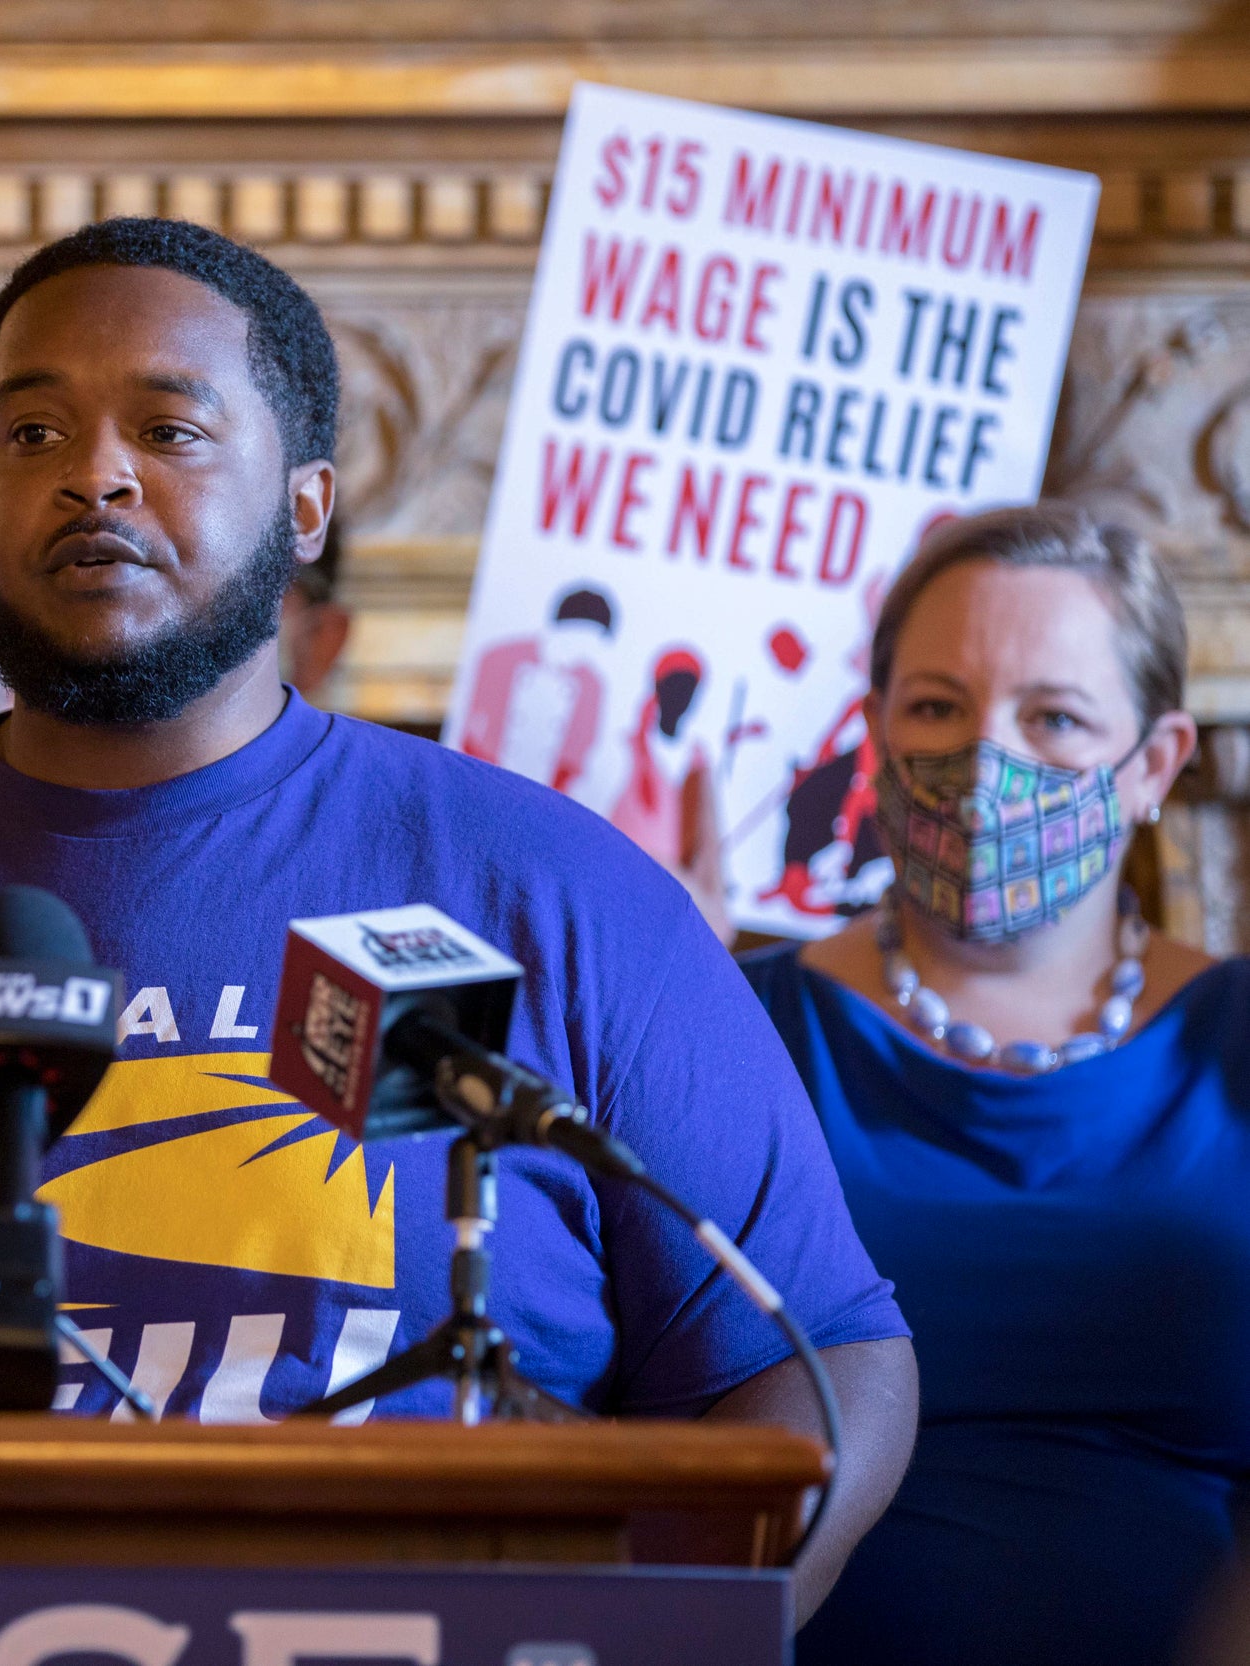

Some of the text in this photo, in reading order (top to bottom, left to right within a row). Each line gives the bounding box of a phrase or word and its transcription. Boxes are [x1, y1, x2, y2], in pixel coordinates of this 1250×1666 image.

[593, 131, 1043, 284] $15 MINIMUM
[580, 230, 1024, 399] WAGE IS THE
[551, 336, 1000, 494] COVID RELIEF
[537, 438, 871, 588] WE NEED
